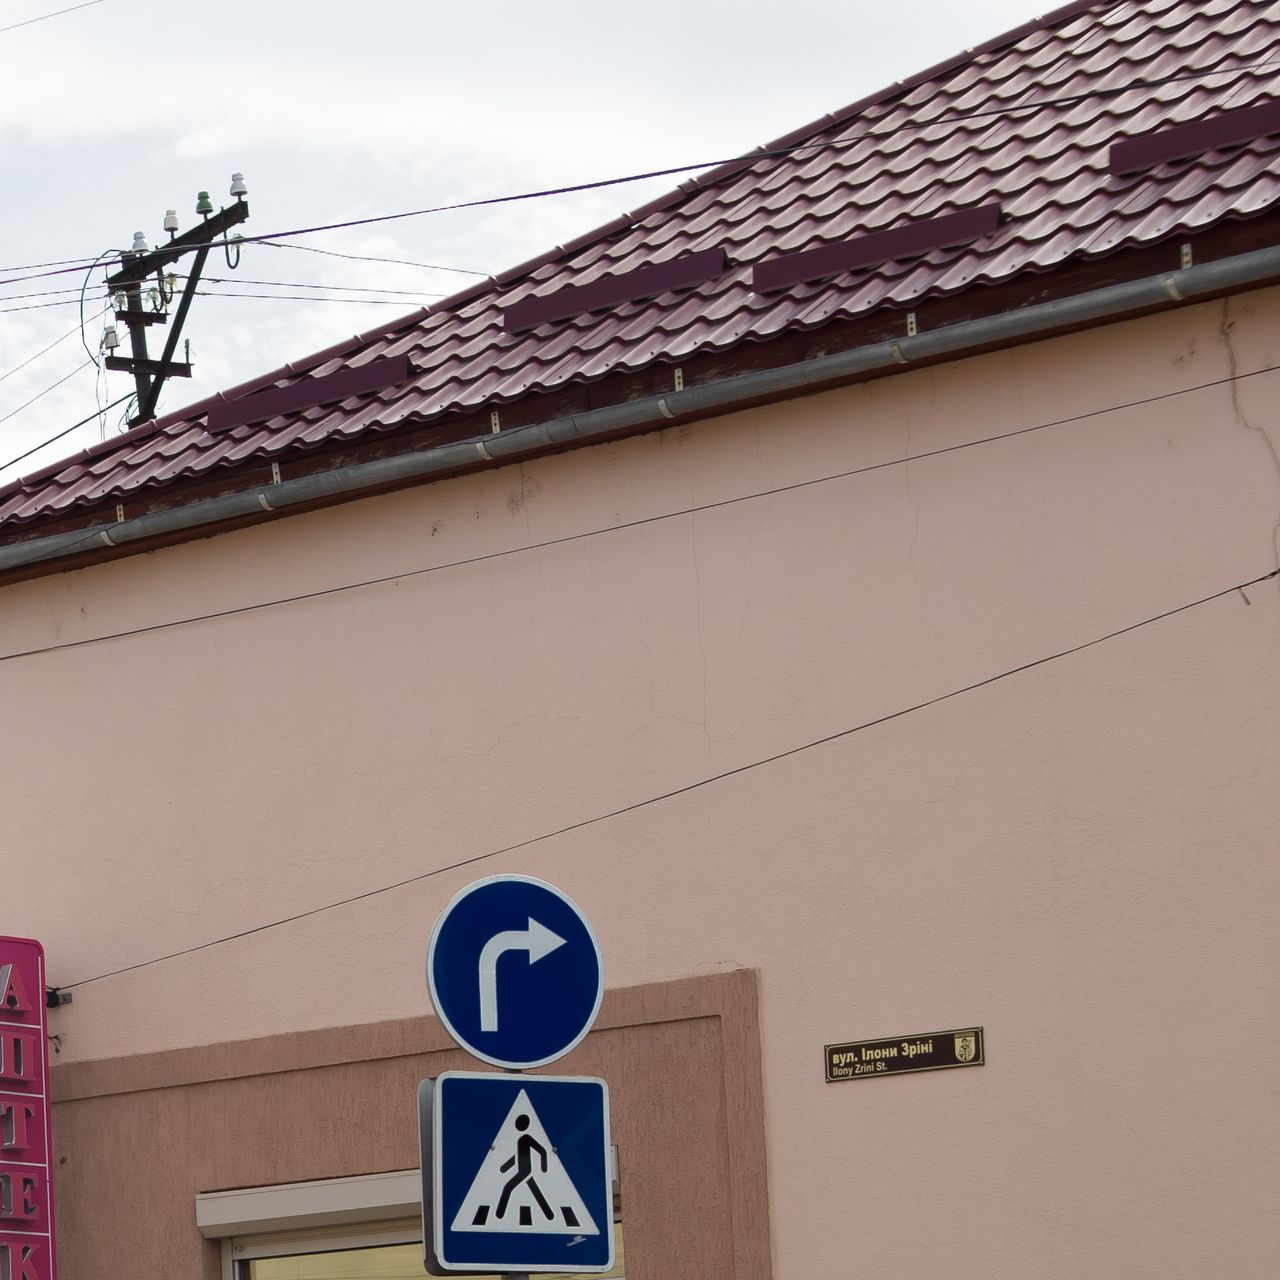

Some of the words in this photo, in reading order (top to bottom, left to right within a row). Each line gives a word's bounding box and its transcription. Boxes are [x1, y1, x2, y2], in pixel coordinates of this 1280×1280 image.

[831, 1051, 858, 1065] вул.
[861, 1046, 898, 1061] Ілони
[900, 1039, 933, 1058] Зріні
[832, 1065, 853, 1078] Ilony
[854, 1063, 875, 1075] Zrini
[875, 1060, 888, 1071] St.
